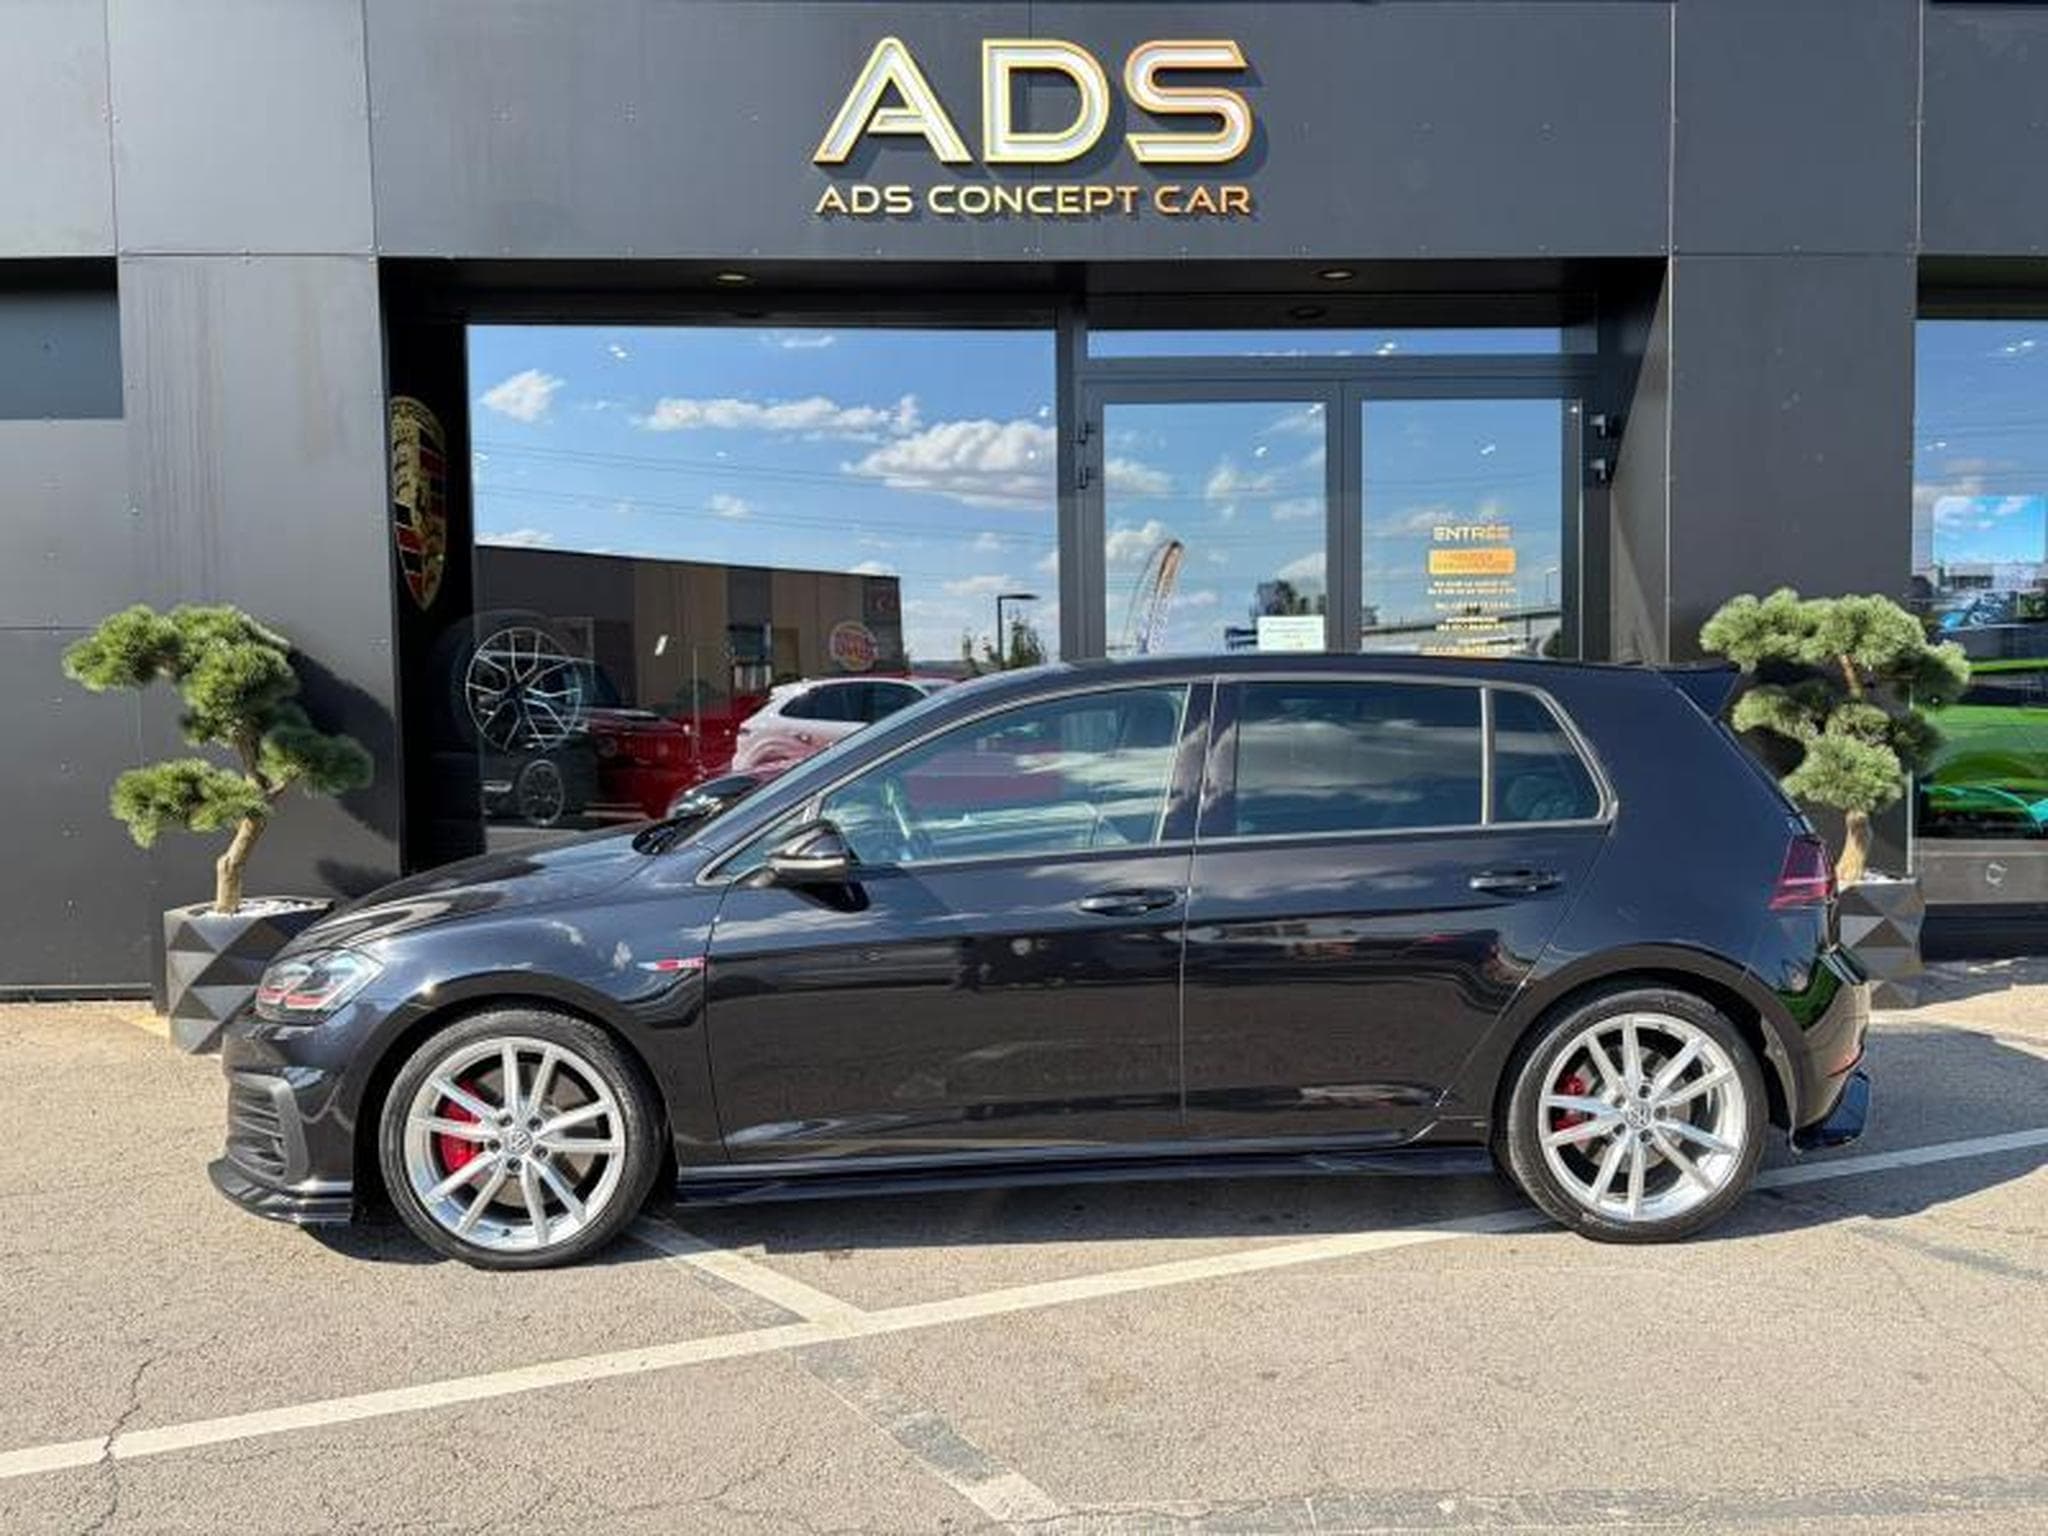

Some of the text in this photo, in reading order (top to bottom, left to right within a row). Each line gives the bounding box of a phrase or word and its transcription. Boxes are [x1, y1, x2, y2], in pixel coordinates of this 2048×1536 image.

[813, 36, 1253, 163] ADS
[815, 184, 1251, 214] ADS CONCEPT CAR
